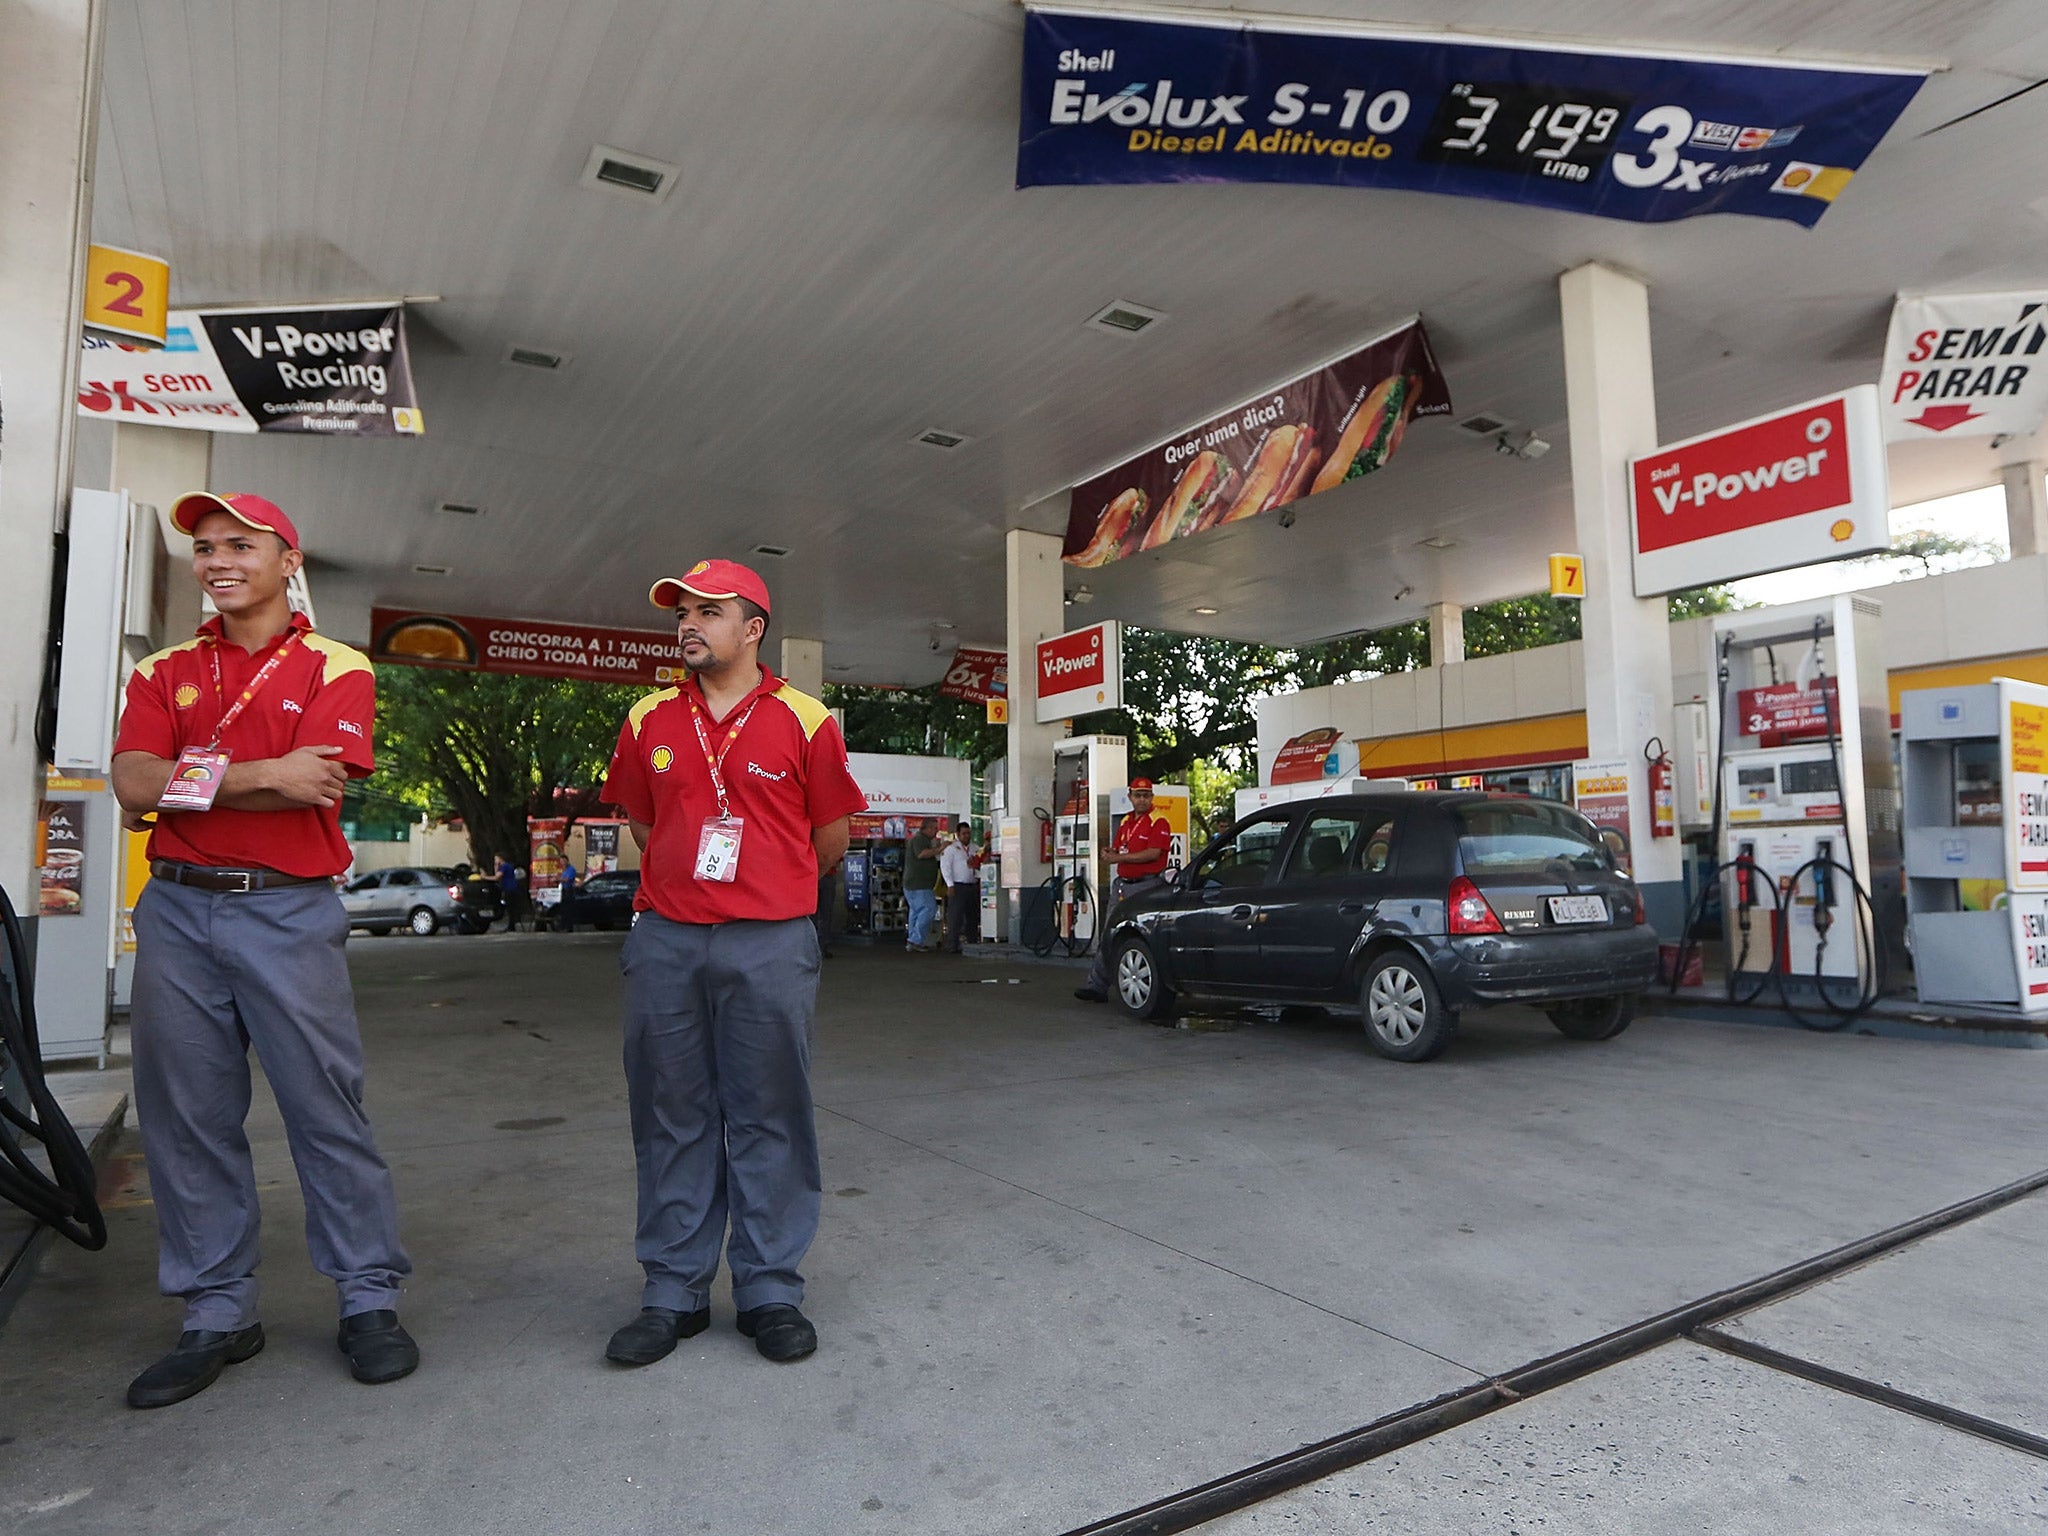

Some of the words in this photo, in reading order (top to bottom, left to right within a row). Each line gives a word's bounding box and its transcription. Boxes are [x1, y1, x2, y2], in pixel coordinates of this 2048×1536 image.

[1058, 48, 1115, 73] Shell
[1050, 79, 1249, 129] Evolux
[1267, 82, 1411, 134] S-10
[1128, 127, 1226, 153] Diesel
[1234, 133, 1393, 160] Aditivado
[1541, 159, 1590, 184] LITRO
[103, 271, 145, 318] 2
[232, 323, 396, 359] V-Power
[1907, 327, 2005, 363] SEM
[143, 372, 213, 393] sem
[276, 358, 388, 396] Racing
[1892, 364, 2030, 404] PARAR
[262, 401, 325, 414] Gasolina
[325, 398, 387, 414] Aditivada
[302, 415, 358, 430] Premium
[1164, 437, 1202, 464] Quer
[1204, 421, 1240, 447] uma
[1242, 395, 1285, 431] dica?
[1650, 462, 1681, 483] Shell
[1651, 447, 1829, 516] V-Power
[1564, 565, 1578, 587] 7
[486, 644, 538, 661] CHEIO
[542, 648, 588, 667] TODA
[488, 629, 584, 650] CONCORRA
[587, 637, 601, 652] A
[619, 640, 682, 659] TANQUE
[1043, 651, 1098, 678] V-Power
[993, 706, 1003, 719] 9
[747, 765, 782, 782] V-Power
[706, 854, 721, 873] 26
